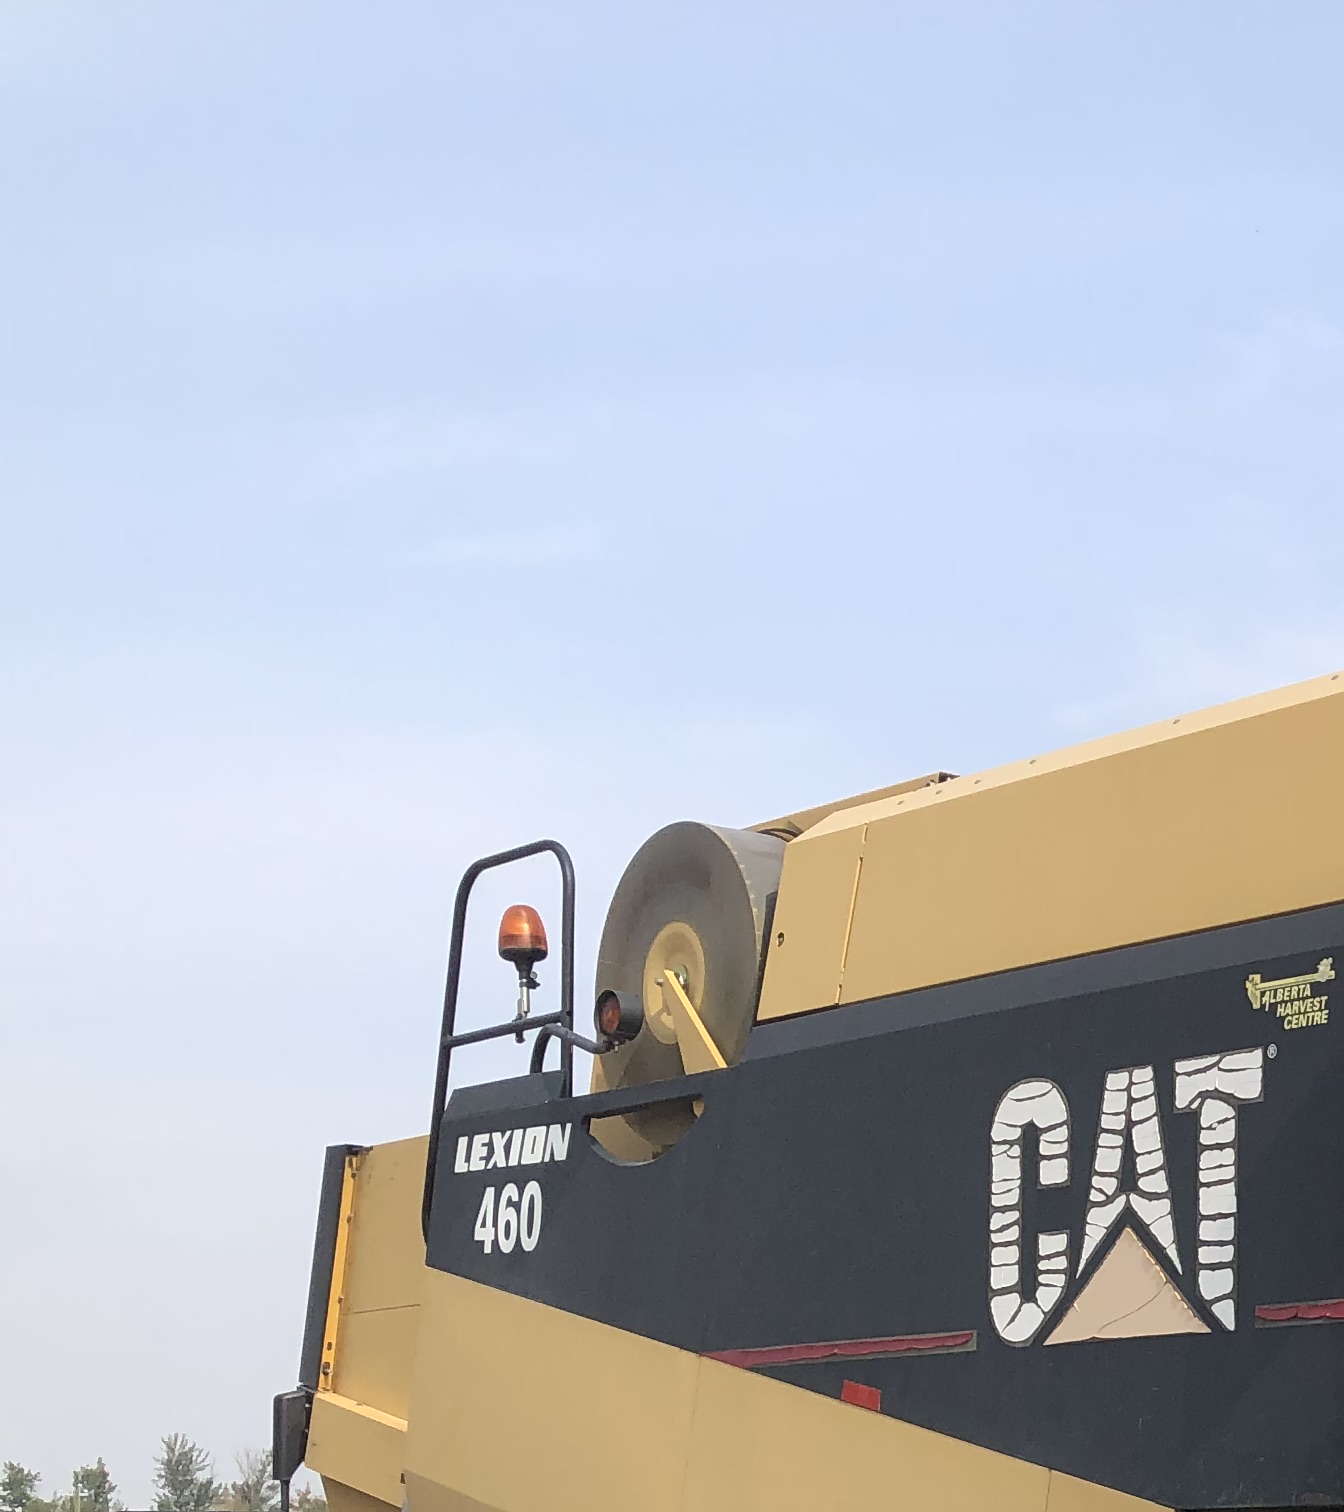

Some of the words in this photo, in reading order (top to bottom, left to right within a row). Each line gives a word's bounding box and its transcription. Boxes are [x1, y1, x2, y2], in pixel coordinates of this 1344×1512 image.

[1261, 983, 1312, 1012] ALBERTA
[1275, 995, 1329, 1018] HARVEST
[1283, 1009, 1330, 1031] CENTRE
[453, 1122, 573, 1174] LEXION
[988, 1046, 1264, 1347] CAT
[473, 1180, 543, 1254] 460
